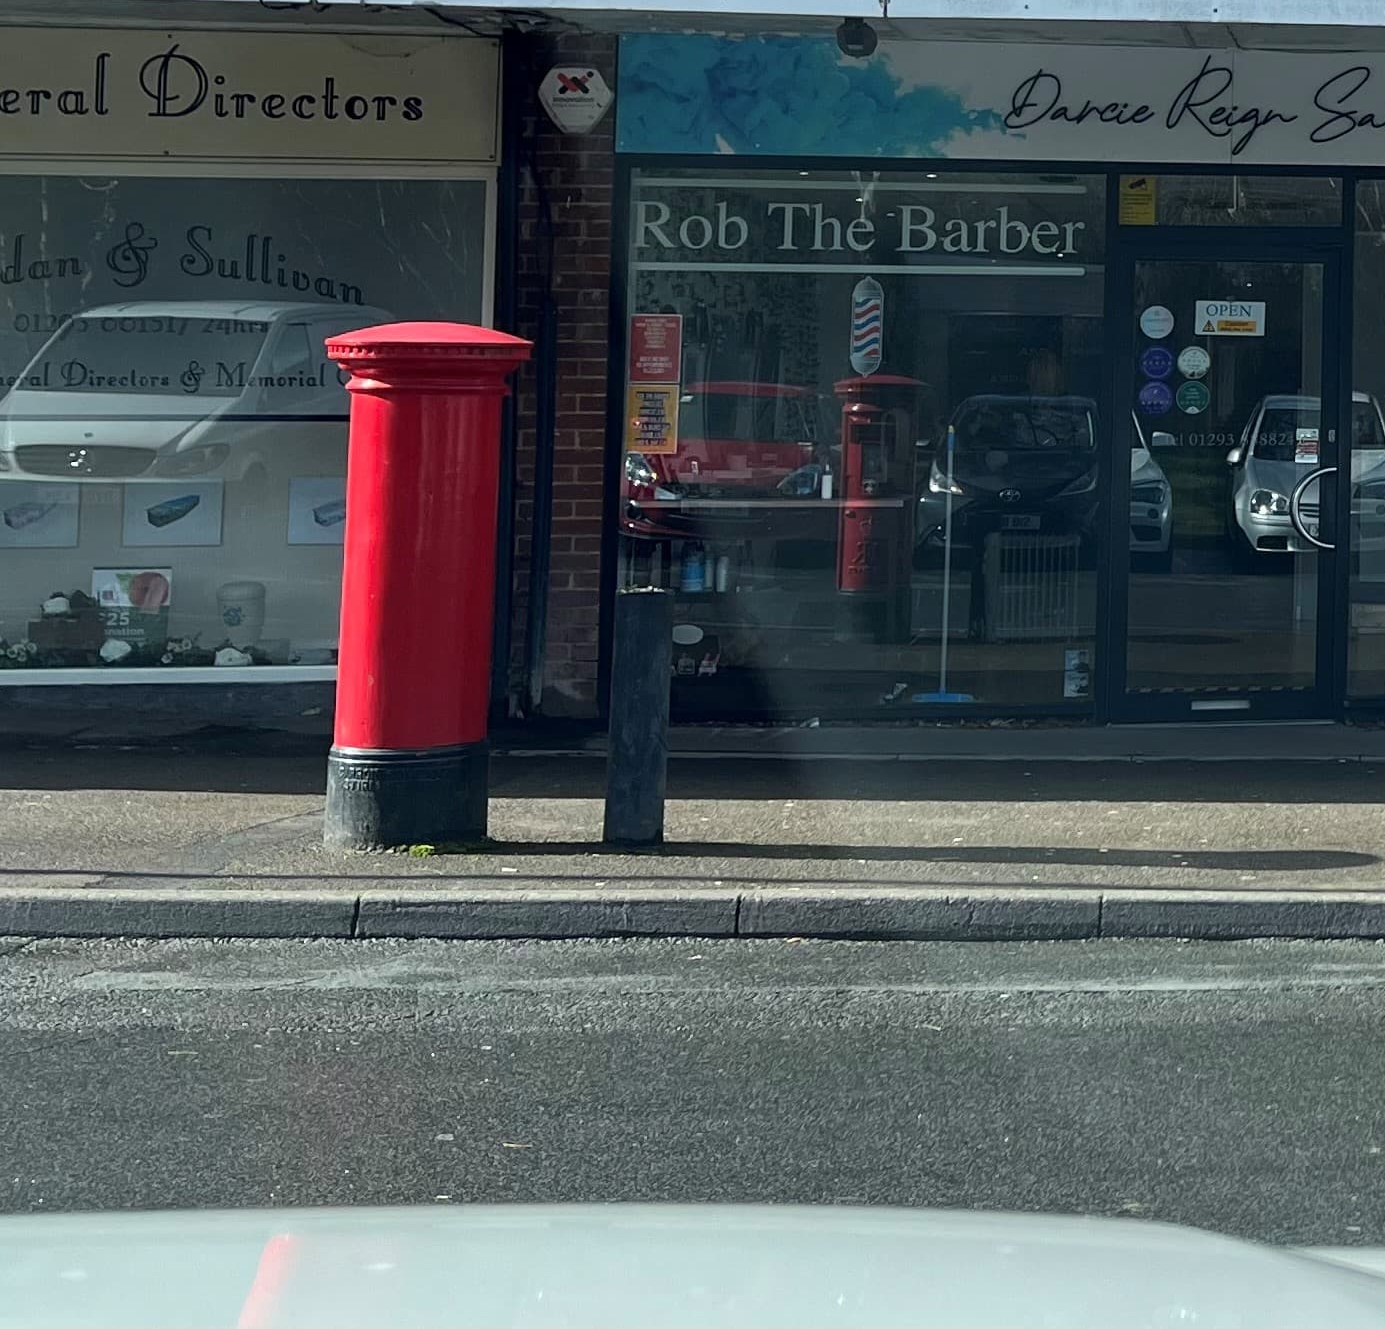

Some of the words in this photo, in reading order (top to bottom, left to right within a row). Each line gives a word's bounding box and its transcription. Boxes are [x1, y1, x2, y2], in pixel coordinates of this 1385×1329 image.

[0, 52, 111, 115] eral
[139, 44, 423, 120] Directors
[1004, 69, 1155, 130] Darcie
[1166, 54, 1298, 155] Reign
[634, 201, 749, 250] Rob
[767, 203, 877, 252] The
[896, 205, 1086, 255] Barber
[0, 233, 83, 285] dan
[106, 222, 158, 288] &
[180, 225, 365, 306] Sullivan
[1206, 303, 1253, 318] OPEN
[61, 358, 170, 388] Directors
[180, 360, 205, 393] &
[215, 361, 327, 388] Memorial
[1189, 433, 1235, 447] 01293
